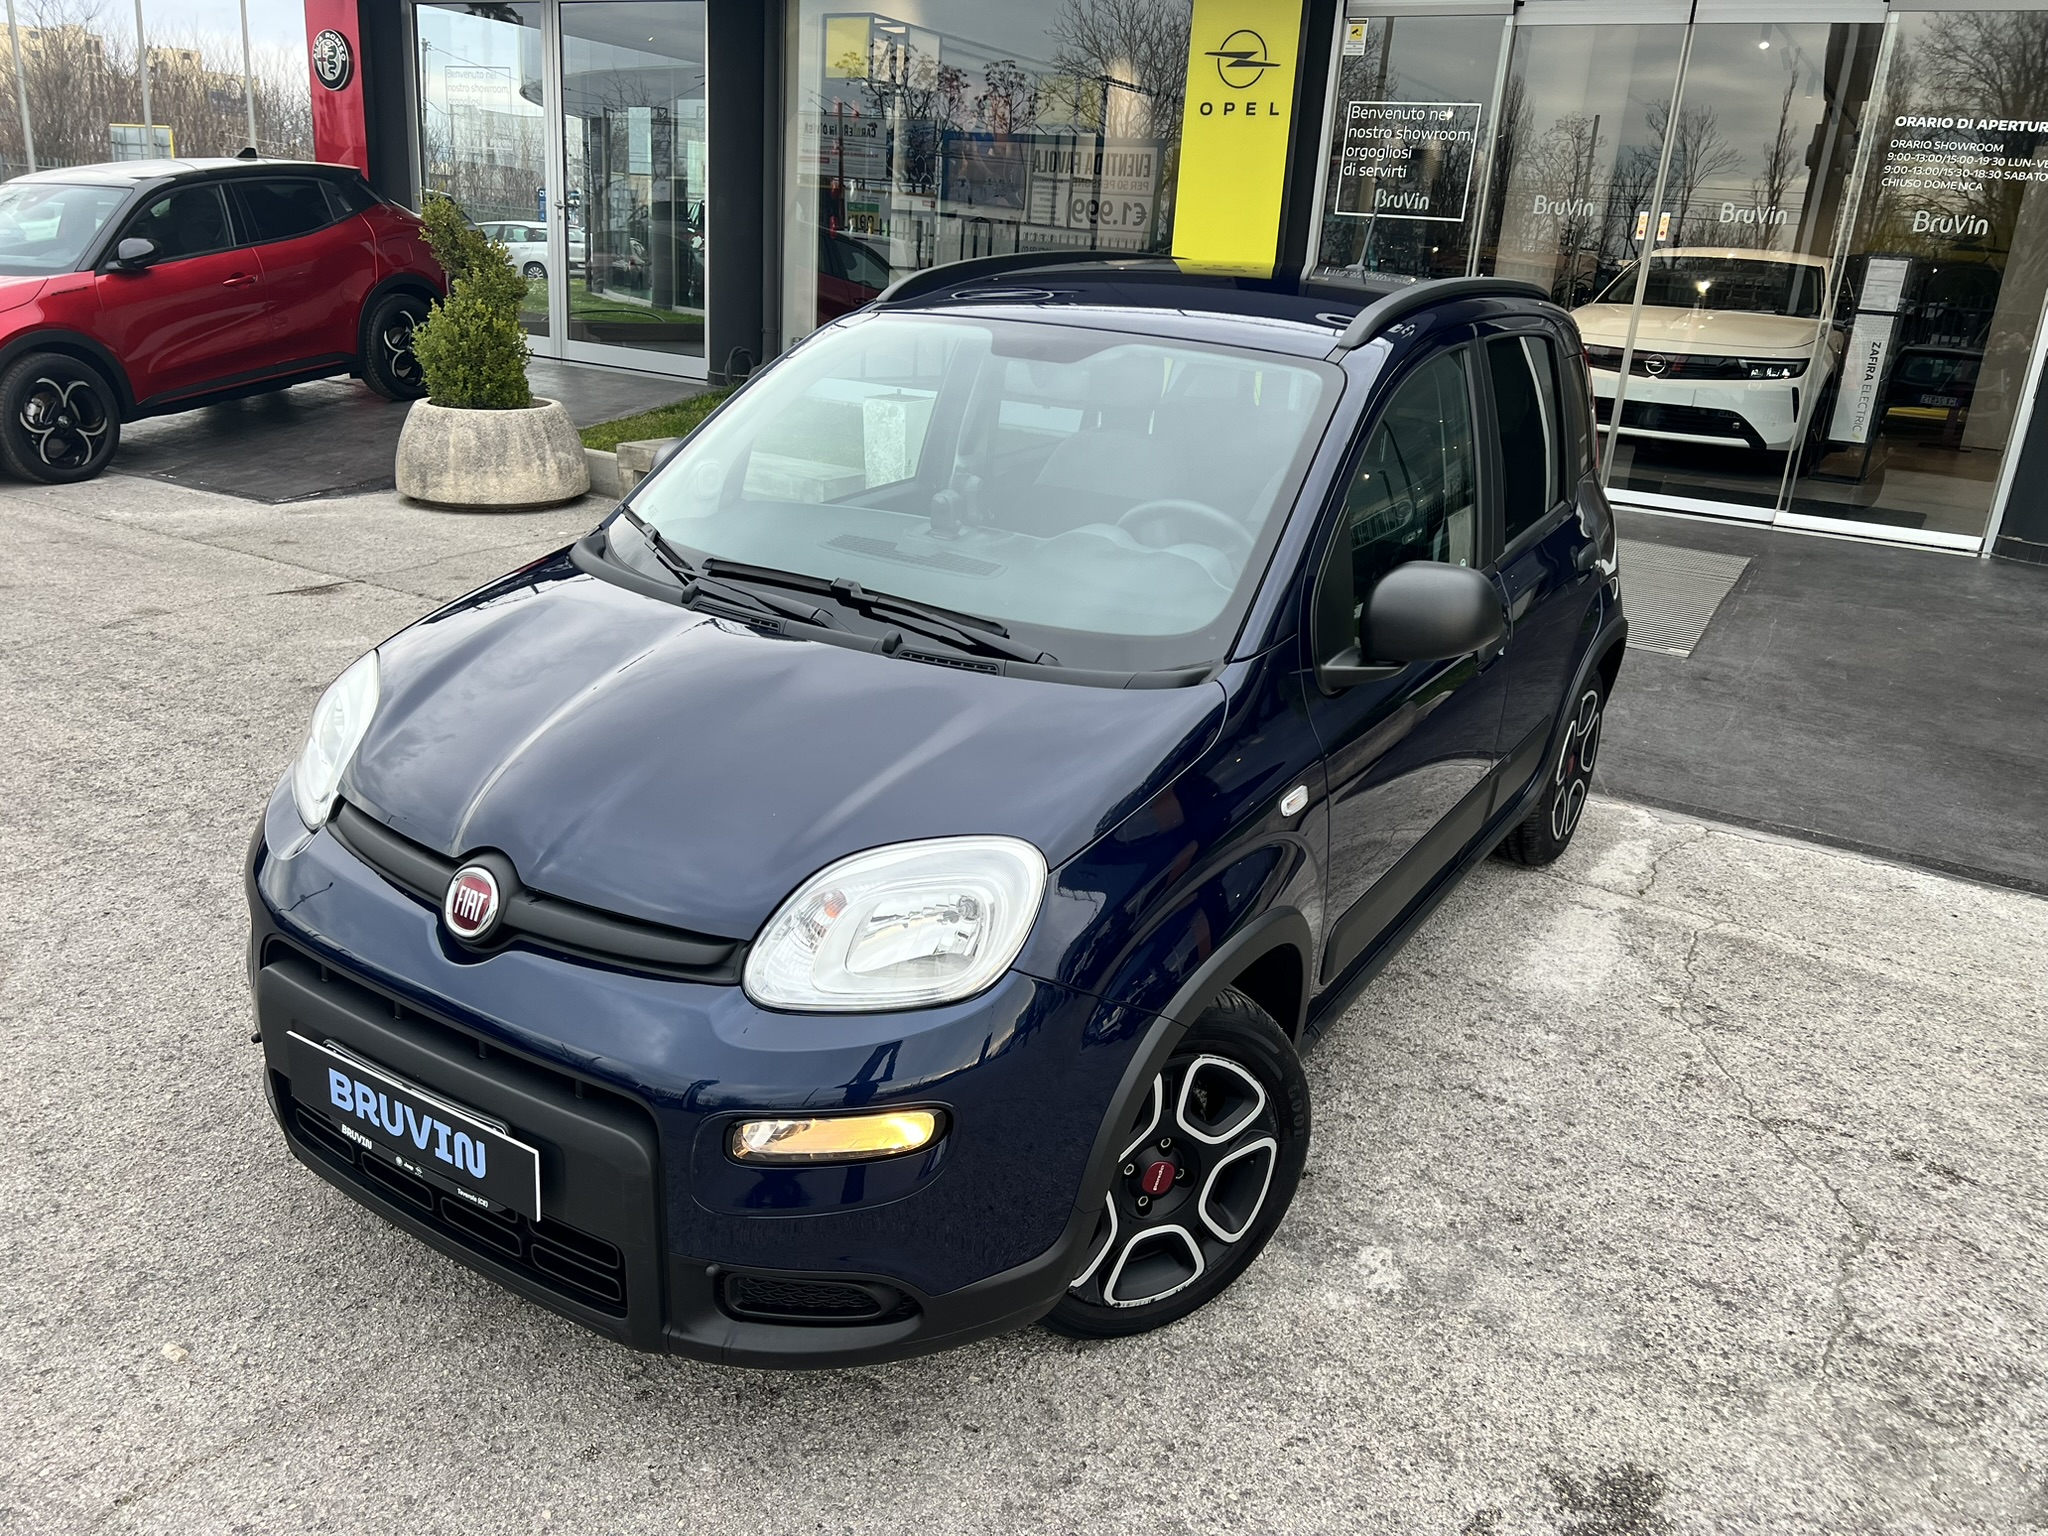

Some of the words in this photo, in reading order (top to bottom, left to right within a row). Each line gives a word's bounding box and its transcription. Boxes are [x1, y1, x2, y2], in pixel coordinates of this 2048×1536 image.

[325, 32, 346, 61] ROMEO
[447, 69, 484, 79] Benvenuto
[447, 84, 470, 92] nostro
[1200, 102, 1279, 116] OPEL
[1351, 105, 1426, 120] Benvenuto
[1895, 116, 1953, 128] ORARIO
[1957, 119, 1975, 129] DI
[1348, 126, 1393, 139] nostro
[1395, 128, 1475, 144] showroom,
[1345, 144, 1413, 161] orgogliosi
[1890, 139, 1932, 150] ORARIO
[1933, 141, 2004, 153] SHOWROOM
[1343, 163, 1356, 176] di
[1358, 164, 1408, 179] servirti
[1882, 178, 1922, 188] CHIUSO
[1924, 180, 1984, 191] DOMENICA
[1374, 188, 1430, 210] BruVin
[1533, 194, 1594, 217] BruVin
[1719, 202, 1788, 225] BruVin
[1913, 210, 1988, 235] BruVin
[1864, 341, 1881, 382] ZAFIRA
[1852, 384, 1871, 431] ELECTRIC
[454, 885, 488, 922] FIAT
[328, 1067, 487, 1179] BRUVIN
[341, 1123, 373, 1150] BRUVIN
